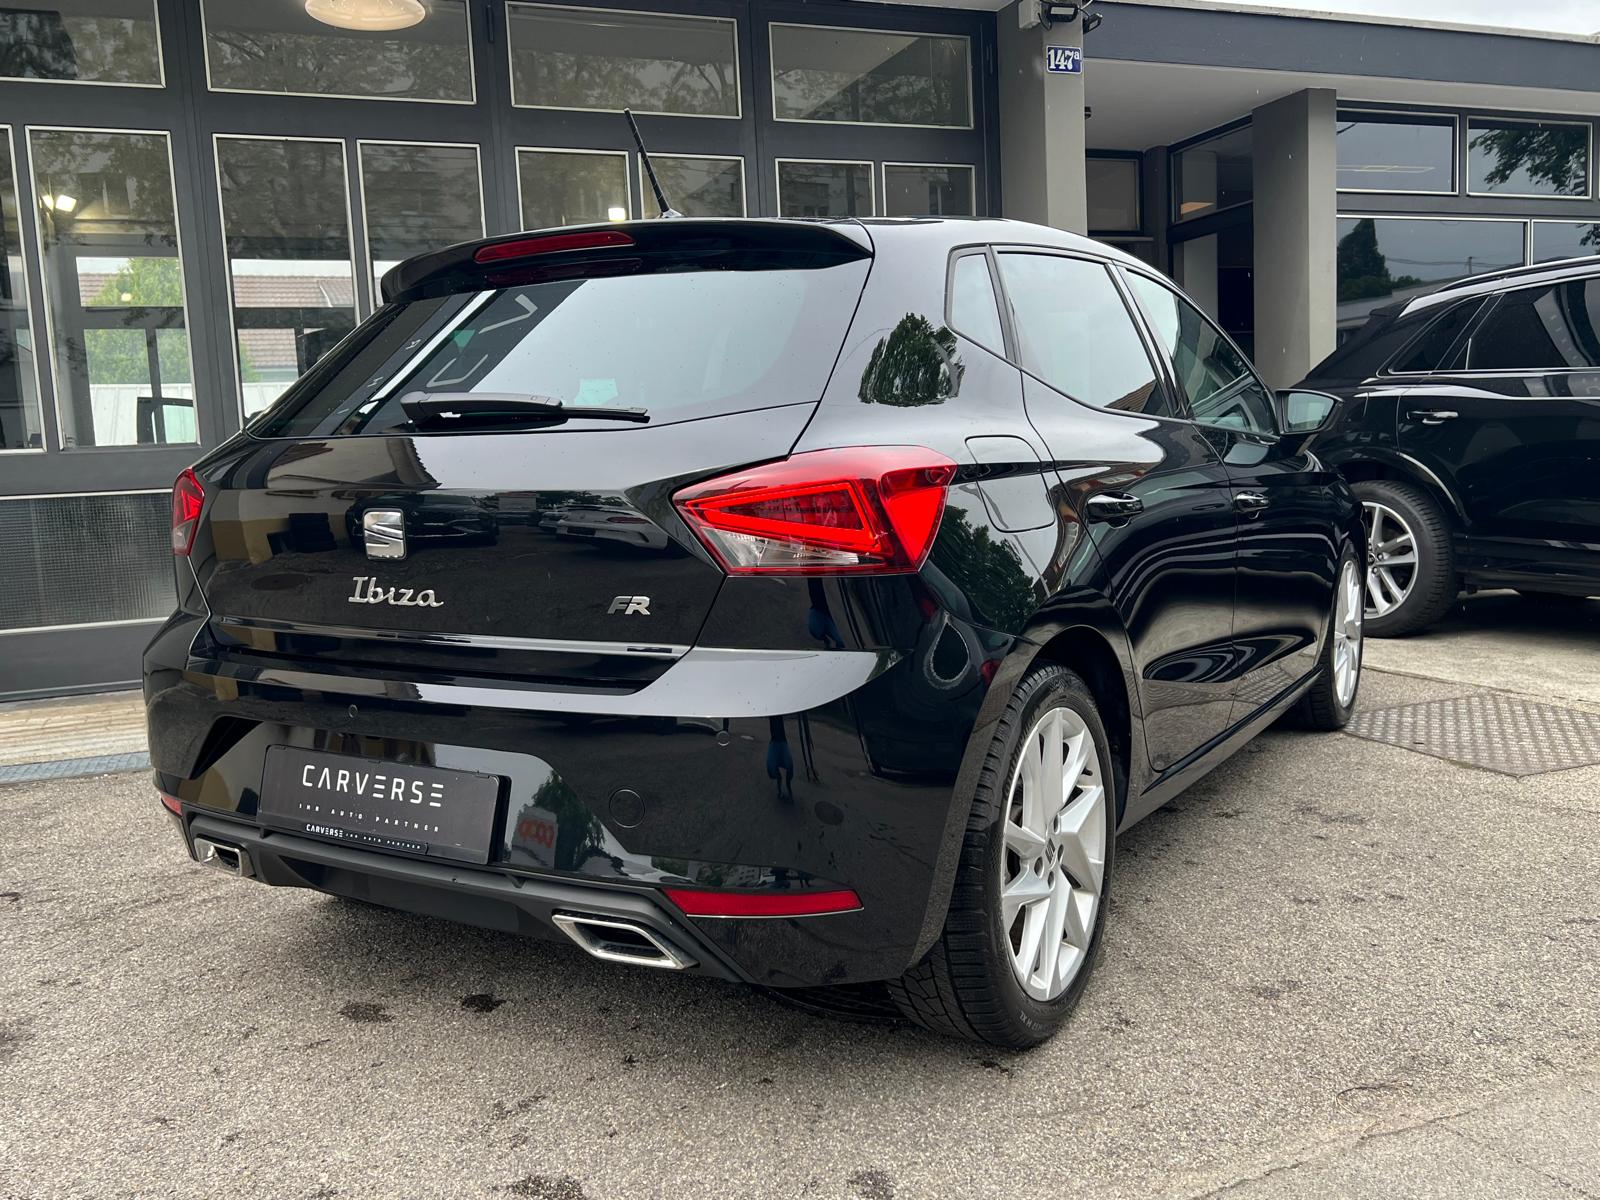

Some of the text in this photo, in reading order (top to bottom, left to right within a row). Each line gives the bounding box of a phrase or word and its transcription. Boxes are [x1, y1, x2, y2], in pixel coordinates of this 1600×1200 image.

[348, 576, 444, 608] Ibiza
[607, 595, 650, 615] FR
[302, 764, 444, 808] CARVERSE
[306, 824, 343, 838] CARVERSE
